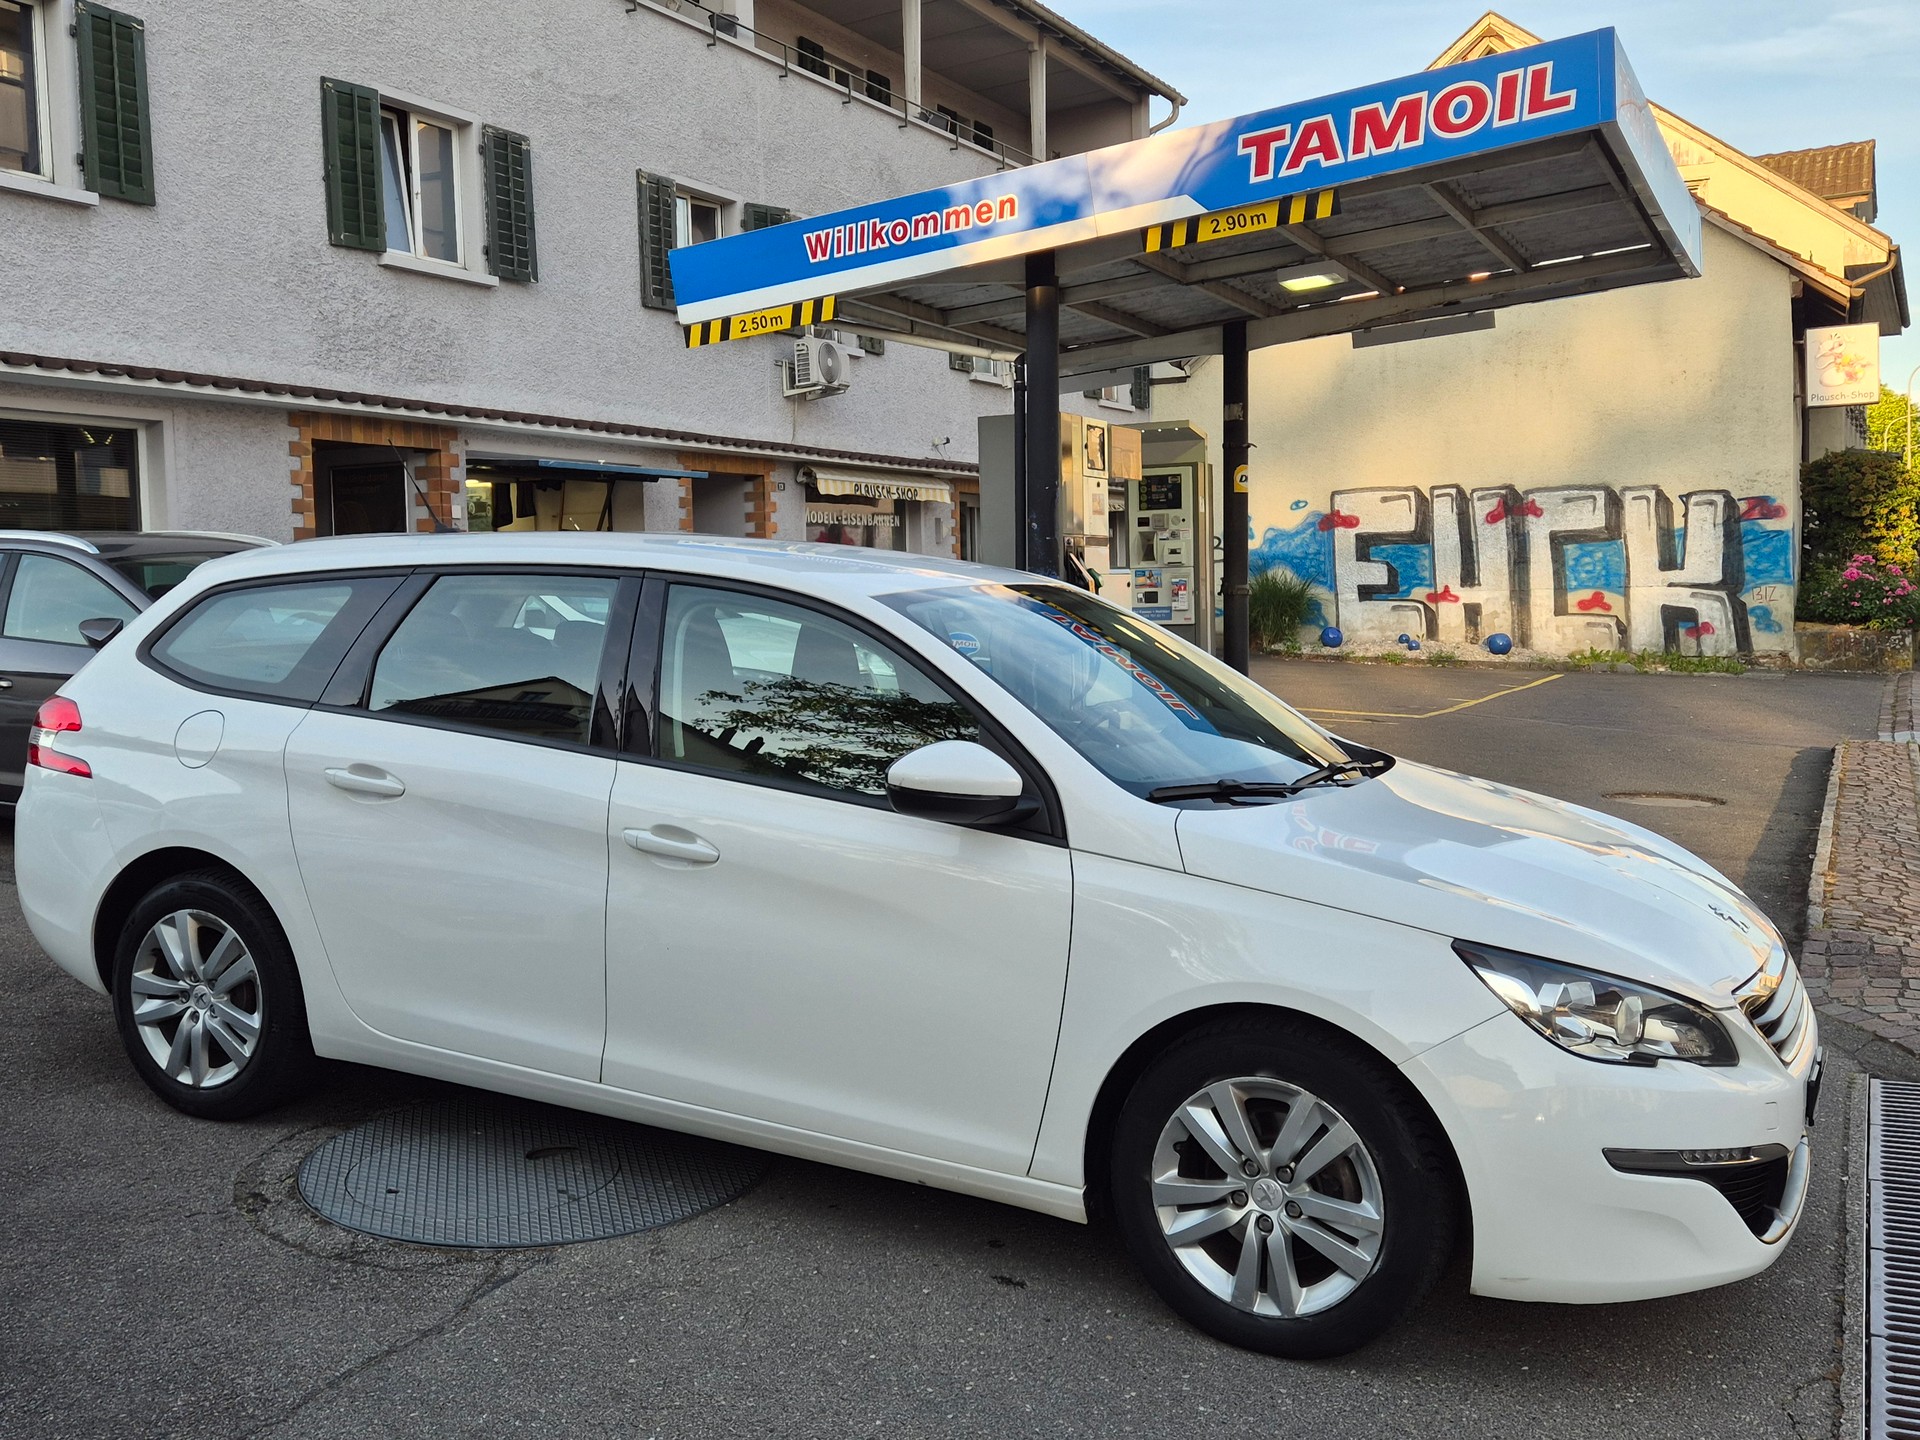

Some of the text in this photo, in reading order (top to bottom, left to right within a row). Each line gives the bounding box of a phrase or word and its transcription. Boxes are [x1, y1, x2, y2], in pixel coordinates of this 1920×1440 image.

[1237, 61, 1577, 184] TAMOIL
[803, 194, 1018, 263] Willkommen
[1210, 212, 1267, 234] 2.90 m
[738, 315, 783, 334] 2.50 m
[1810, 390, 1875, 402] Plausch-Shop
[853, 483, 918, 501] PLAUSCH-SHOP
[953, 640, 978, 648] MOIL
